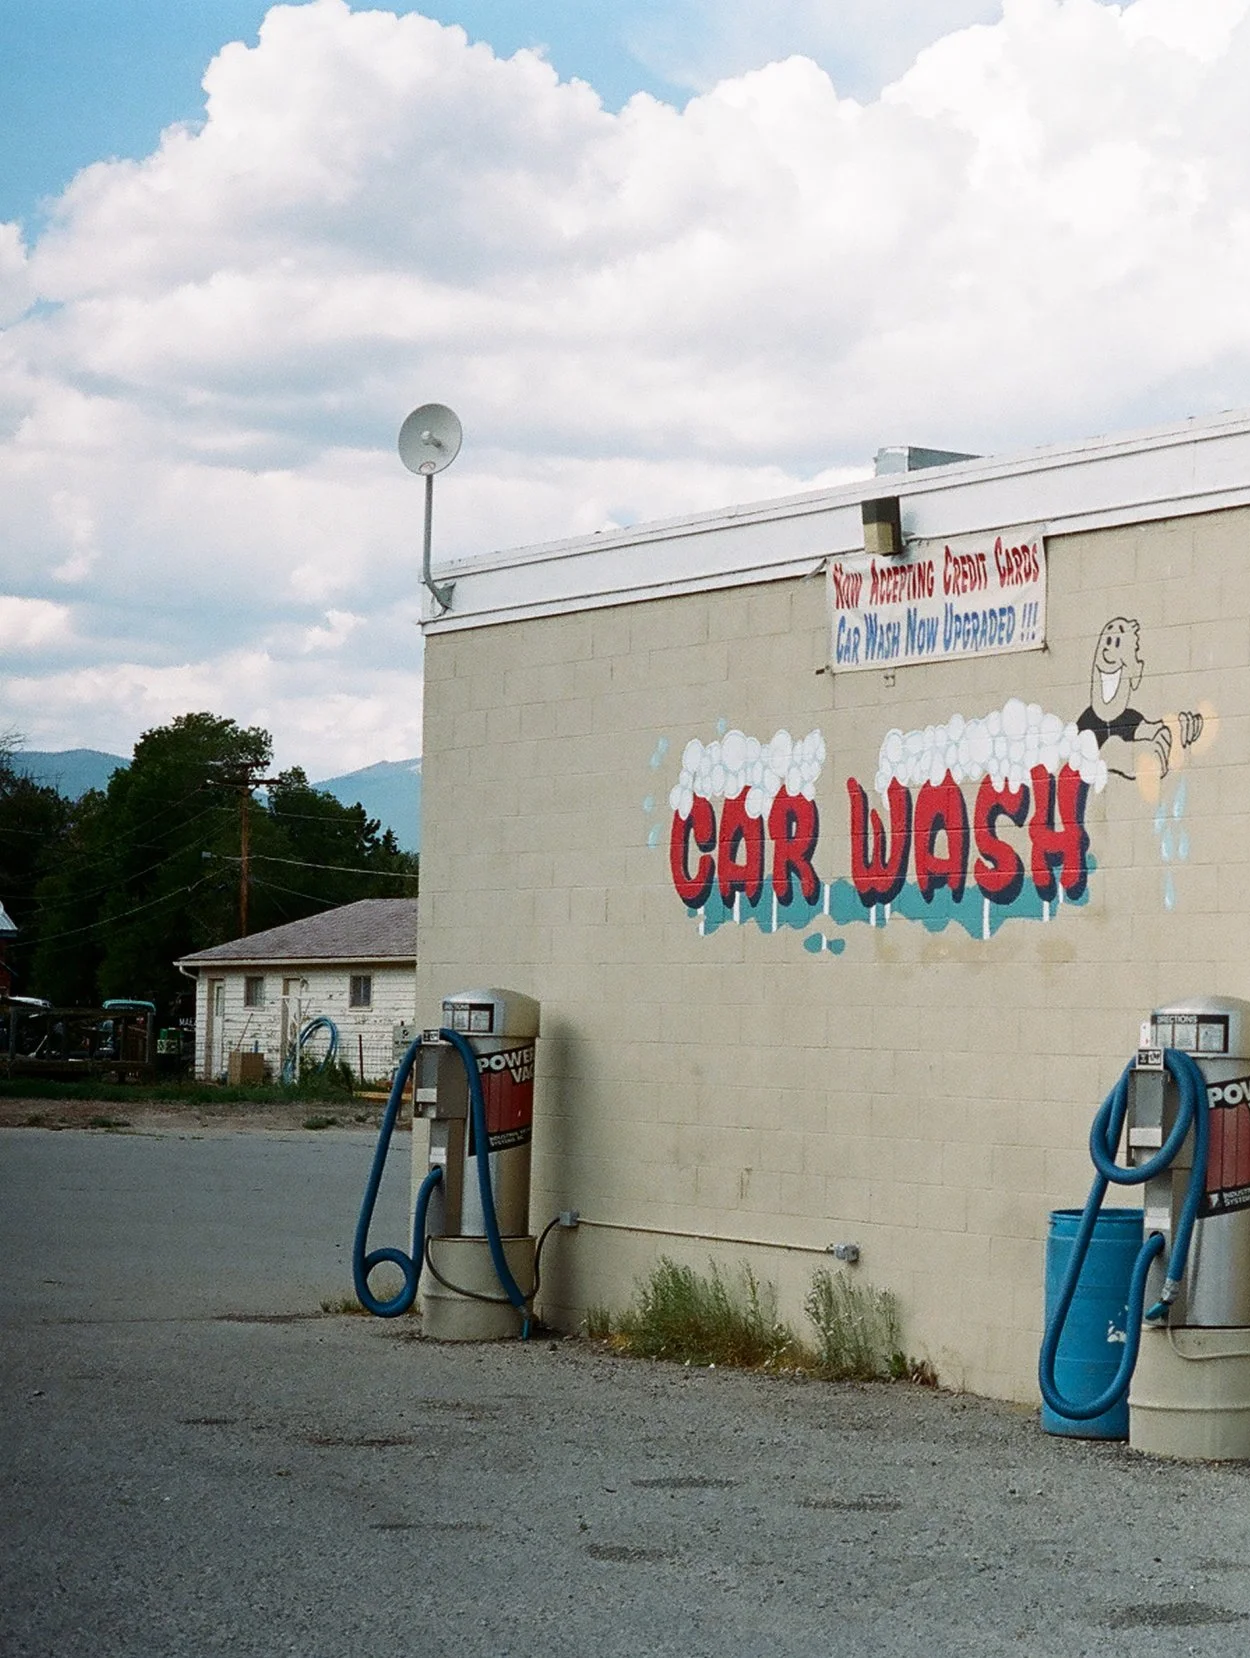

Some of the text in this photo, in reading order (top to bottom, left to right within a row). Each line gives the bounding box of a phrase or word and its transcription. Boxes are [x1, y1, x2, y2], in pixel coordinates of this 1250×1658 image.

[833, 536, 1040, 609] NOW ACCEPTING CREDIT CARDS
[836, 615, 860, 665] CAR
[864, 613, 900, 661] WASH
[905, 607, 939, 656] NOW
[943, 602, 1016, 653] UPGRADED
[669, 762, 1091, 909] CAR WASH
